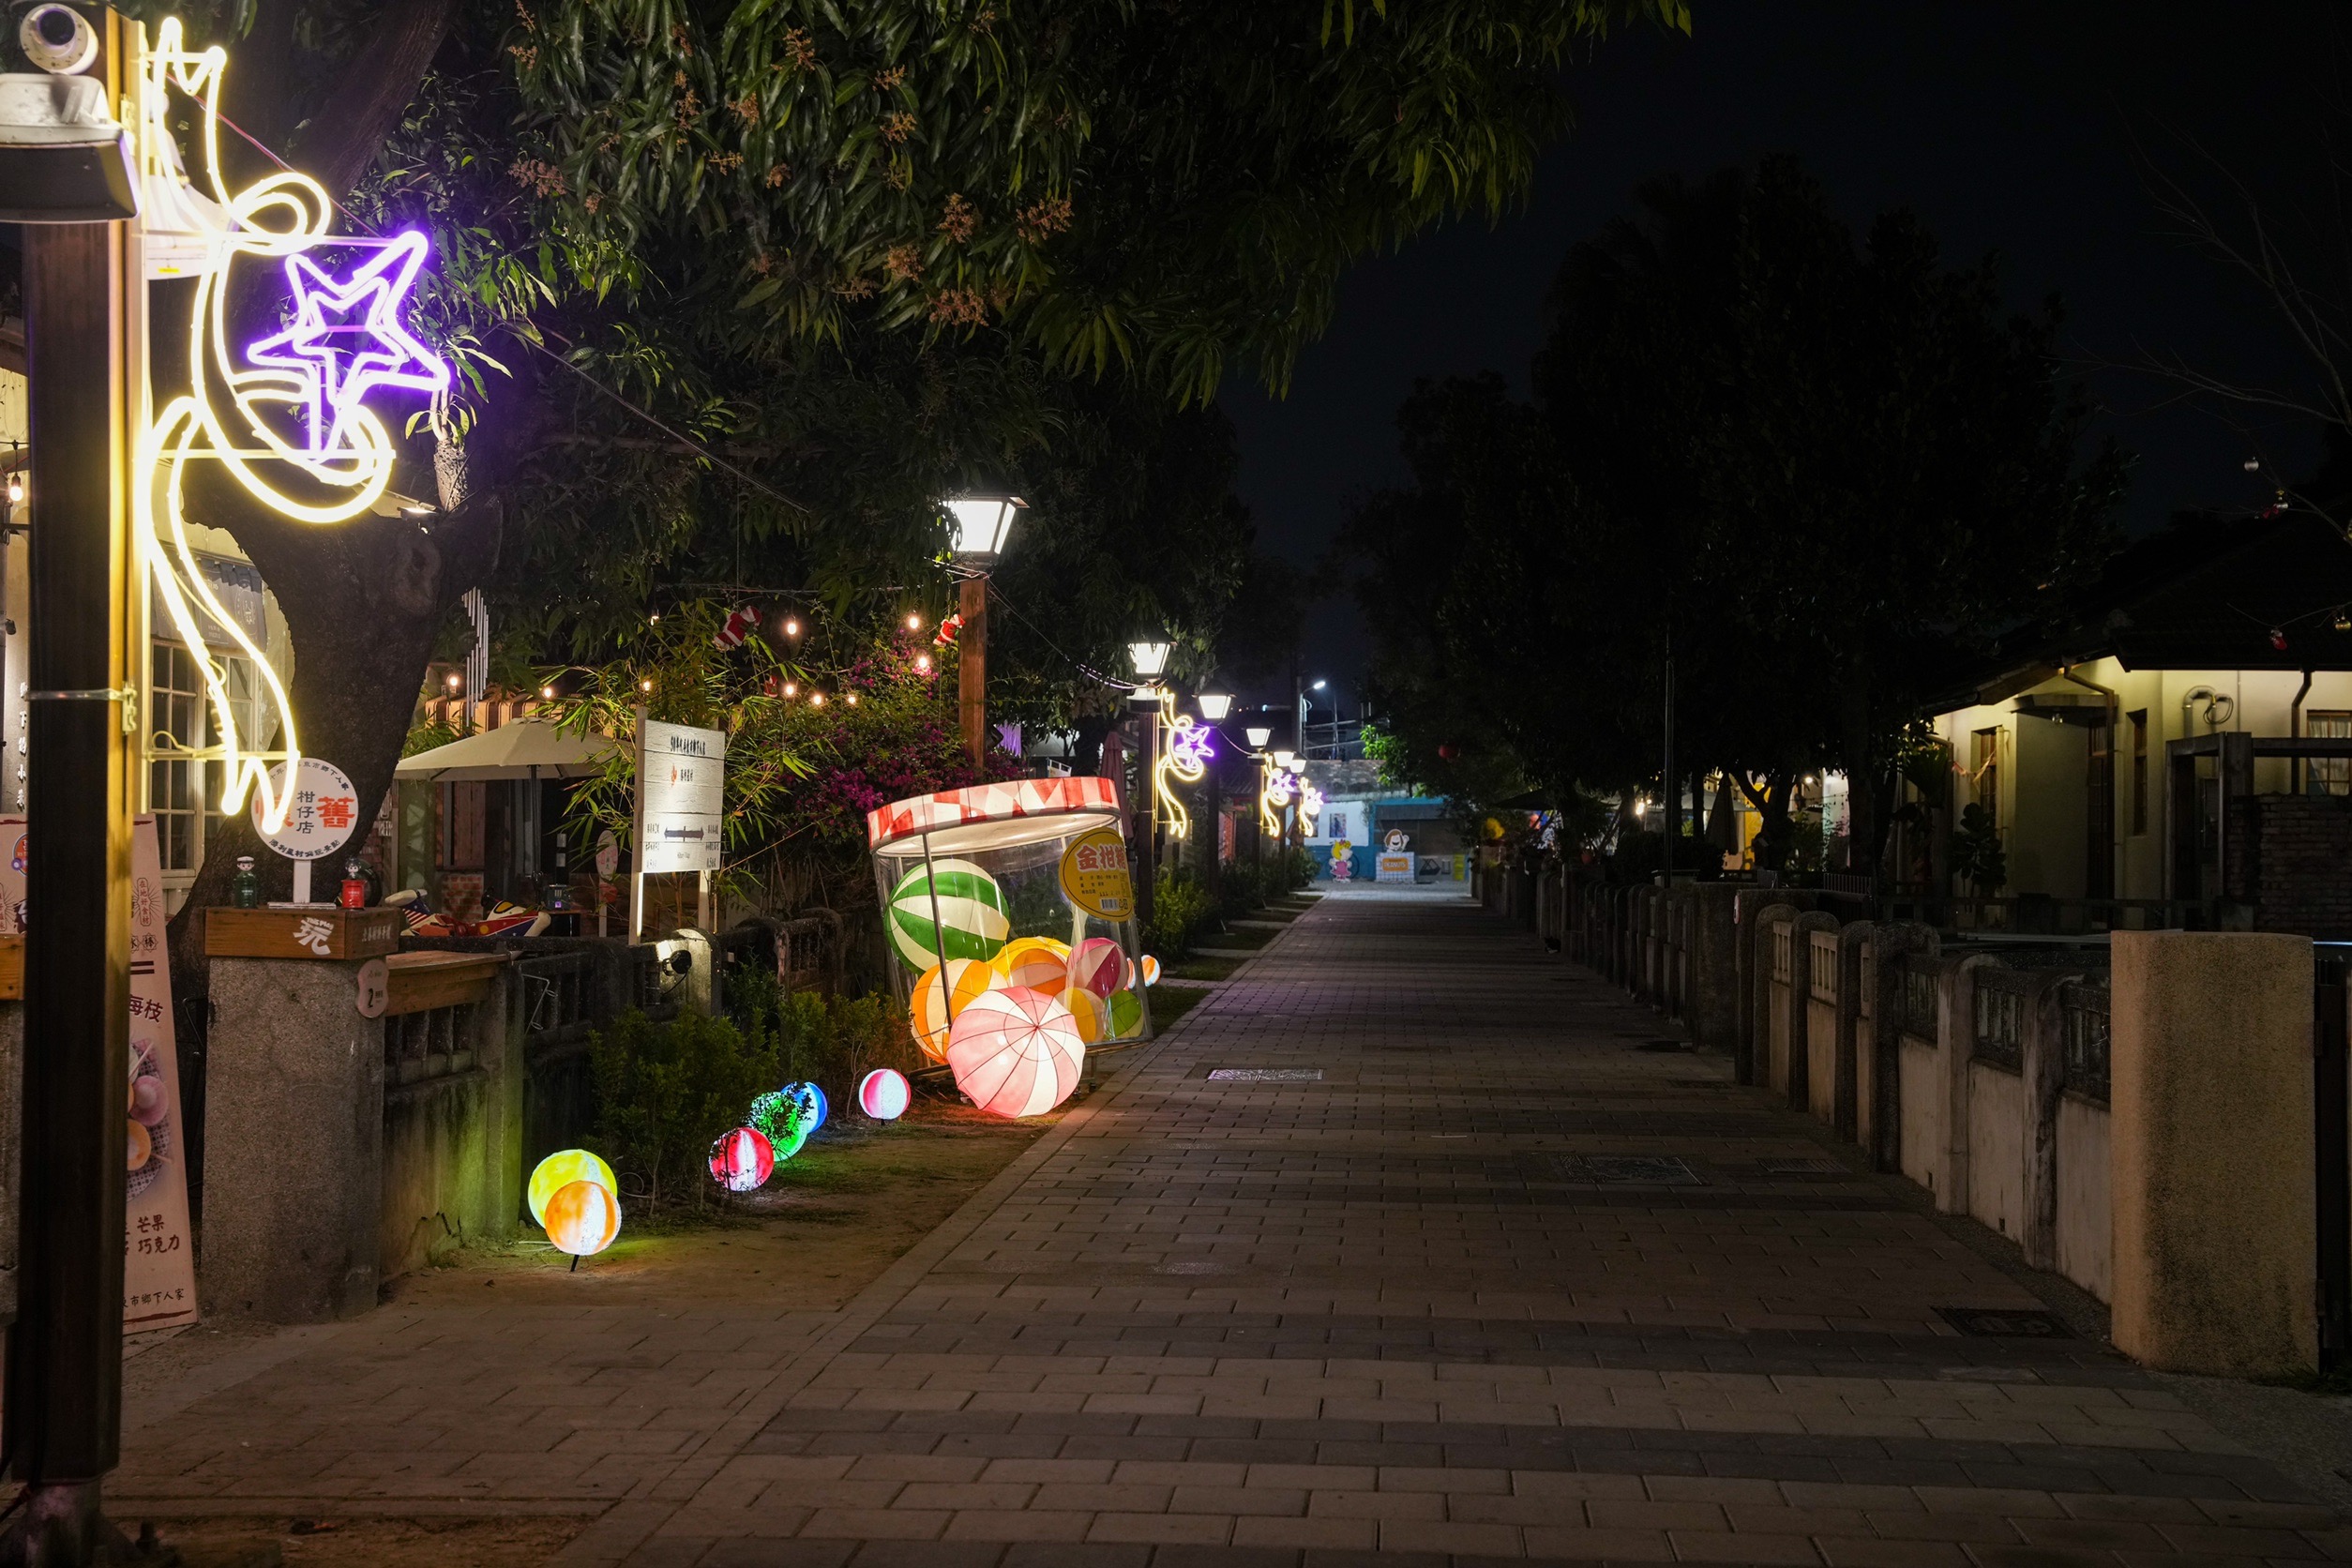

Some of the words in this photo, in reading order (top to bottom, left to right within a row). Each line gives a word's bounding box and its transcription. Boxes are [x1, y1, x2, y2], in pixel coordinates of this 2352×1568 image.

[295, 790, 315, 834] 柑仔店
[316, 796, 355, 829] 舊
[139, 880, 150, 925] 在地好食材
[293, 919, 332, 956] 玩
[368, 988, 374, 1009] 2
[137, 1214, 164, 1233] 芒果
[138, 1234, 180, 1255] 巧克力
